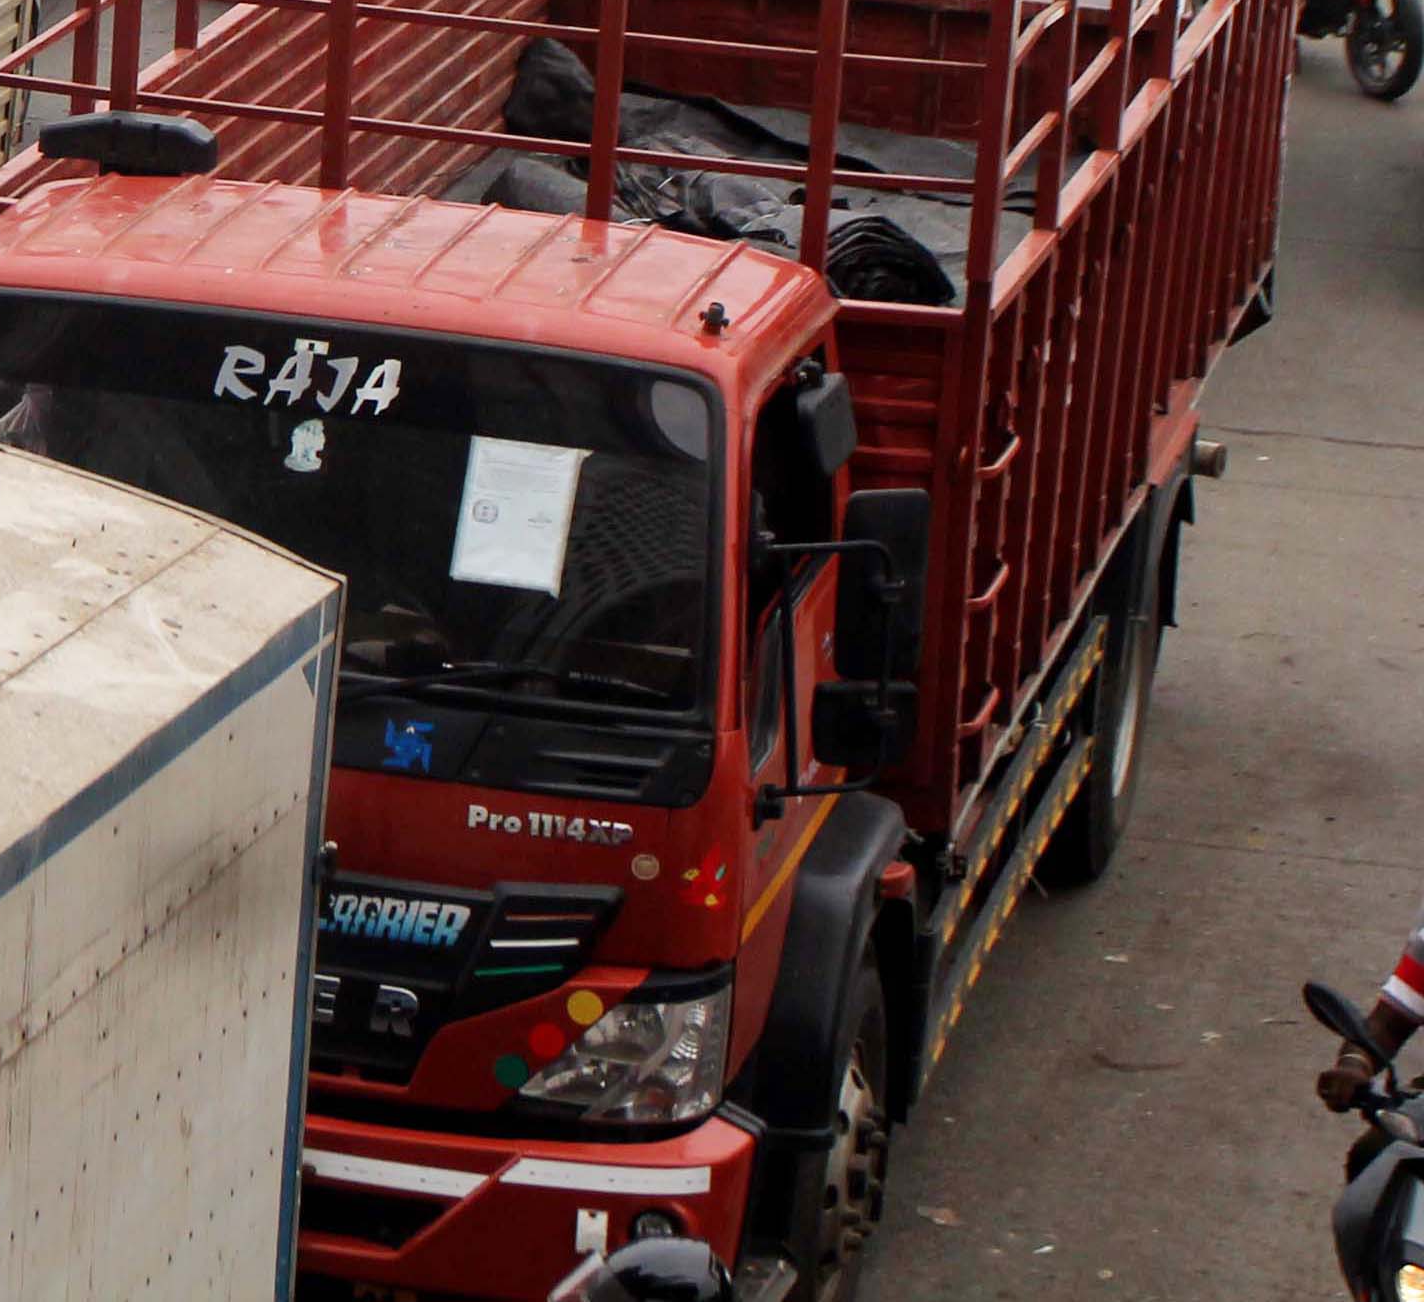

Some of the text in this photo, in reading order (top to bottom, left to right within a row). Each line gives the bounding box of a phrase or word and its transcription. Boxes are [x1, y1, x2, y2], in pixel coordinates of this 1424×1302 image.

[214, 345, 401, 416] RAJA
[467, 804, 634, 845] Pro 1114XP
